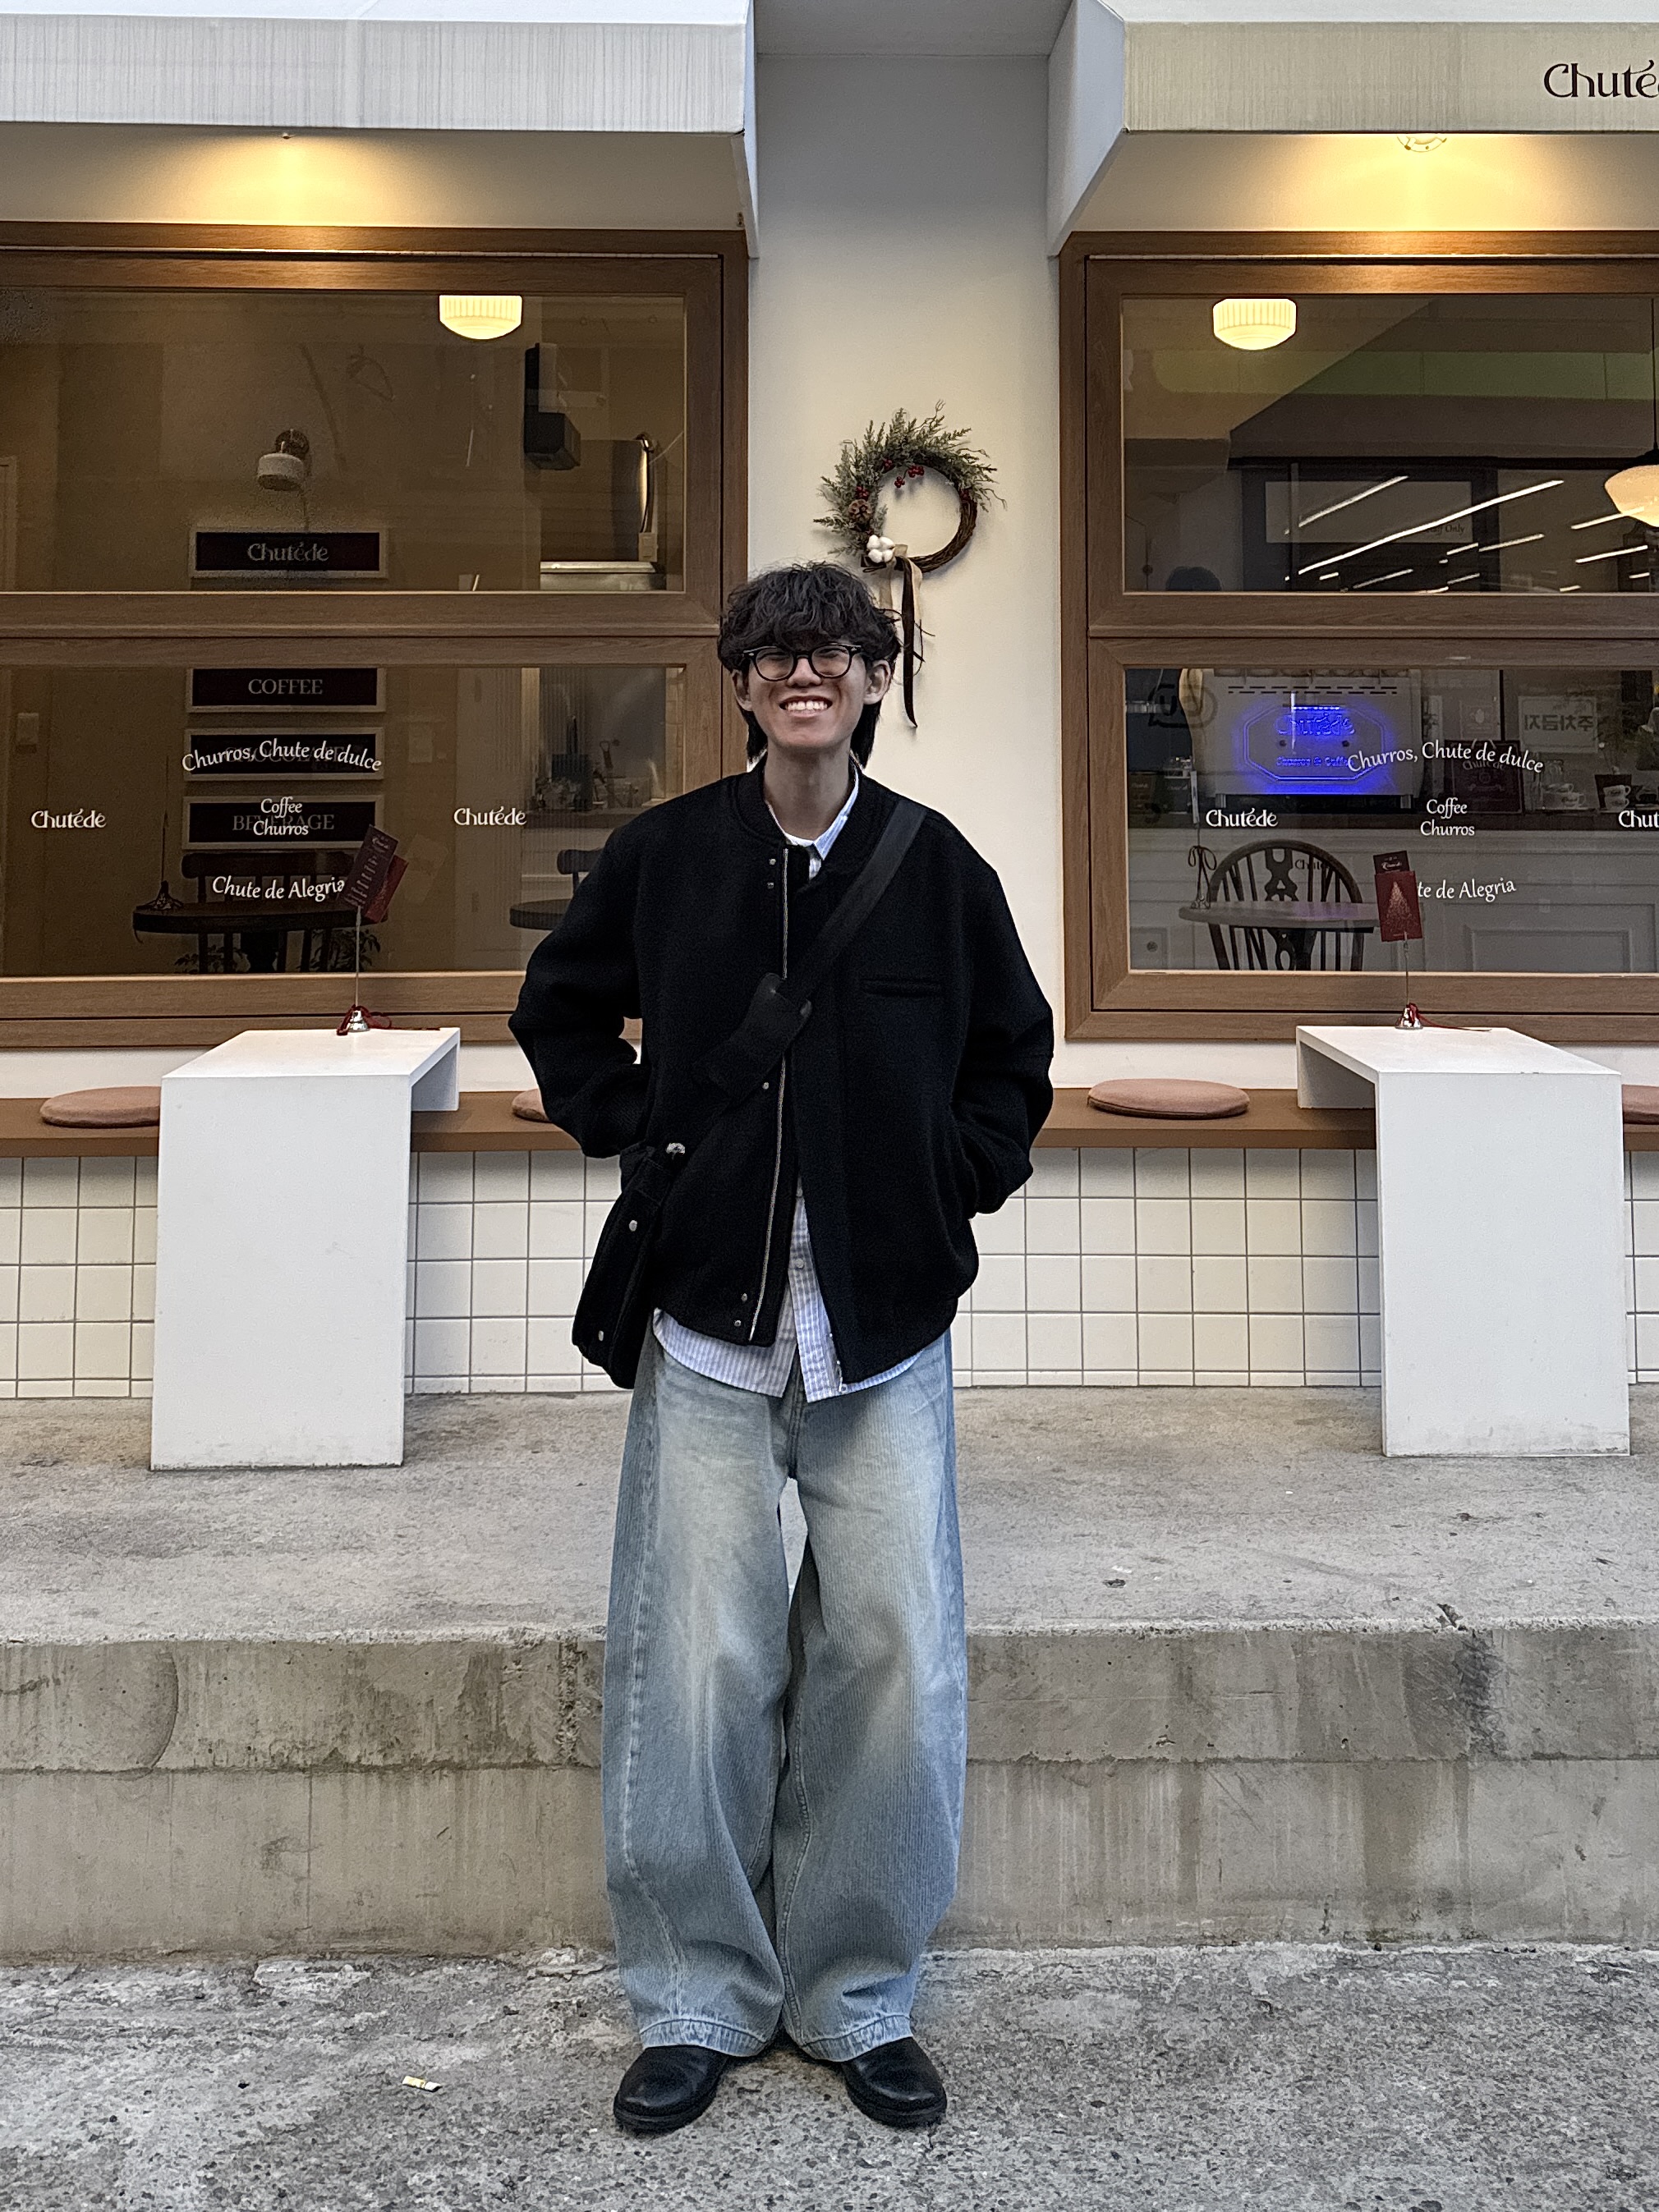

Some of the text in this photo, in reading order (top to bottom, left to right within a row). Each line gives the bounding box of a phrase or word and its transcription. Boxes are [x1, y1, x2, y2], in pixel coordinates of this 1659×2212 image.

[1543, 59, 1659, 98] Chuté
[248, 678, 323, 695] COFFEE
[182, 738, 382, 772] Churros, Chute de dulce
[1347, 740, 1544, 773] Churros, Chute de dulce
[260, 796, 303, 819] Coffee
[1426, 797, 1468, 819] Coffee
[253, 819, 309, 836] Churros
[1420, 819, 1475, 836] Churros
[212, 875, 345, 902] Chute de Alegria
[1436, 879, 1455, 899] de
[1459, 877, 1517, 902] Alegria
